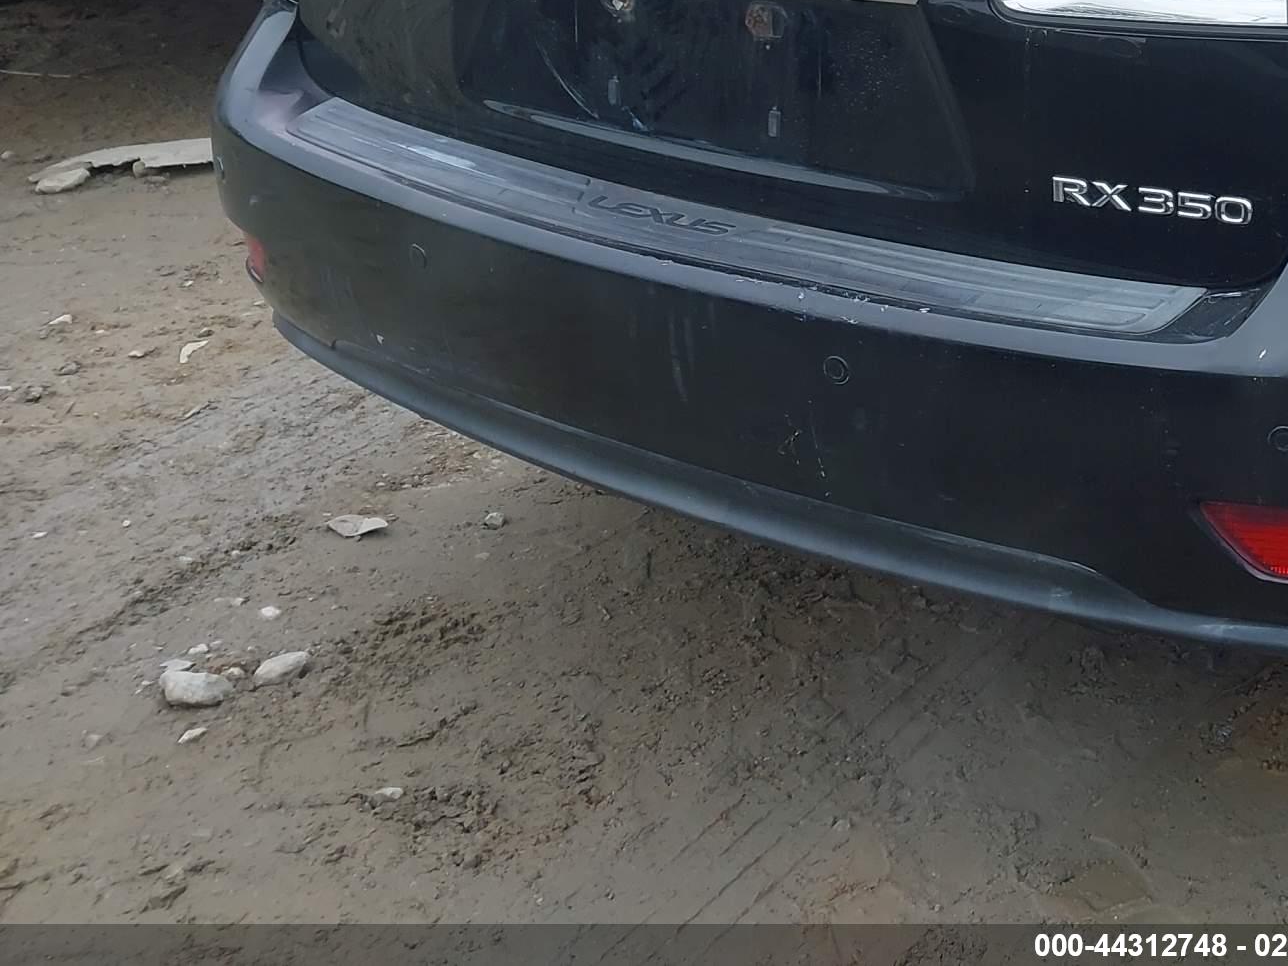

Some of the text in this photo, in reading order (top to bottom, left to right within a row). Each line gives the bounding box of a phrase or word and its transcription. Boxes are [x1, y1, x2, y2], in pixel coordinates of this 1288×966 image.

[588, 195, 737, 236] LEXUS
[1052, 176, 1253, 225] RX 350
